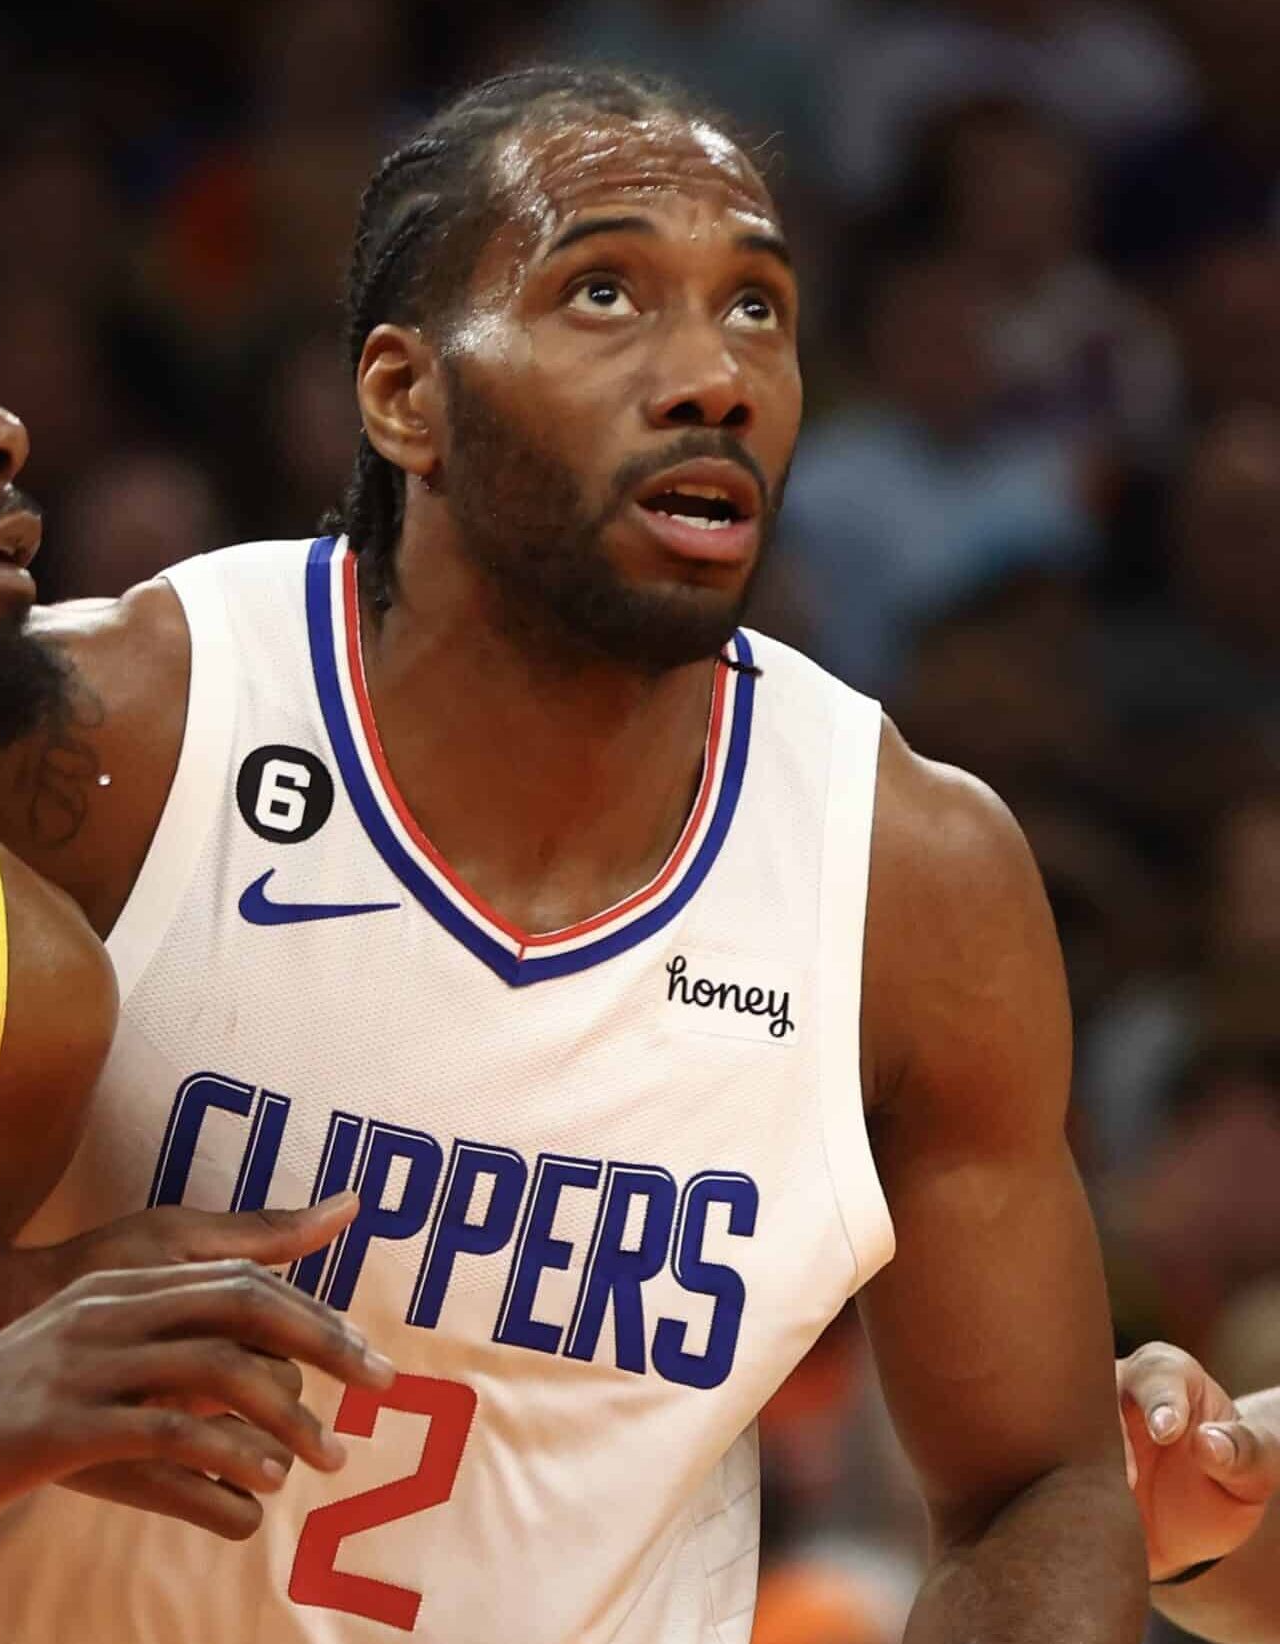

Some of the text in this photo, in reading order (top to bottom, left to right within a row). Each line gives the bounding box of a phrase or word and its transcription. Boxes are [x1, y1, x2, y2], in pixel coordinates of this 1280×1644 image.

[255, 758, 311, 832] 6
[666, 955, 795, 1039] honey
[146, 1071, 760, 1391] CLIPPERS
[288, 1371, 478, 1632] 2
